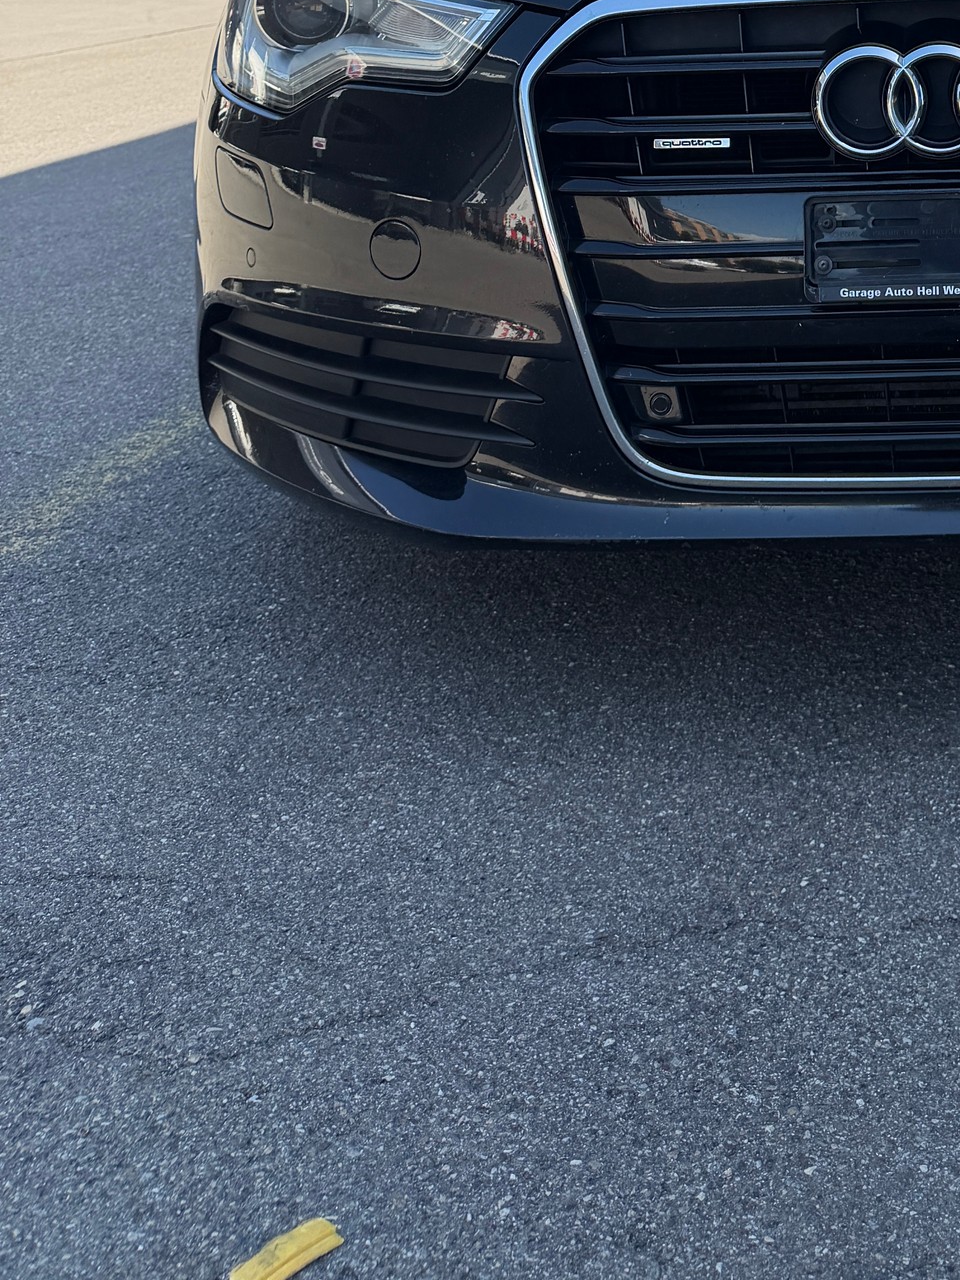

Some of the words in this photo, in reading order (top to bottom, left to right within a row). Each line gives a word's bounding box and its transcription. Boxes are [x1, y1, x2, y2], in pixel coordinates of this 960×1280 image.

[660, 139, 723, 148] quattro
[839, 287, 882, 300] Garage
[884, 286, 914, 297] Auto
[917, 285, 940, 296] Hell
